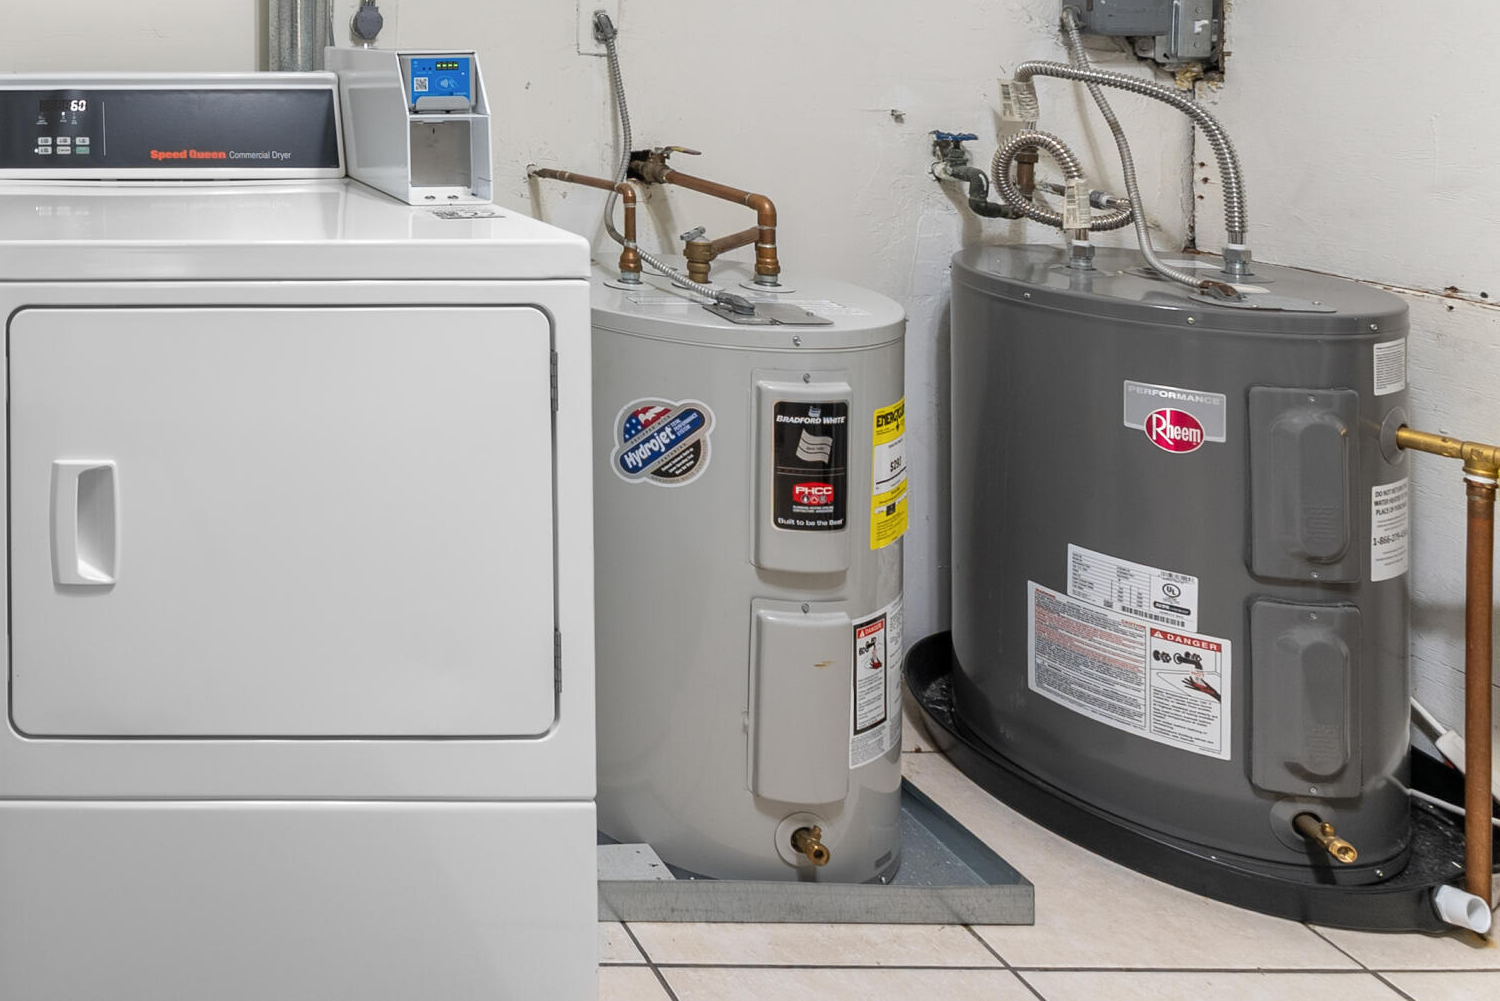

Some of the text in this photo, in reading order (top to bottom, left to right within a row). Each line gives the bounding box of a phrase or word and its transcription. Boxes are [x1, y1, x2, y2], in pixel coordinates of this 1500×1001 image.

[71, 100, 86, 111] 60
[150, 149, 291, 161] Speed Queen Commercial Dryer
[1127, 385, 1222, 405] PERFORMANCE
[776, 415, 846, 424] BRADFORD WHITE
[1152, 408, 1200, 445] Rheem
[624, 424, 676, 468] Hydrojet
[796, 486, 832, 494] PHCC
[1166, 586, 1176, 595] UL
[865, 622, 882, 634] DANGER
[1167, 633, 1218, 651] DANGER
